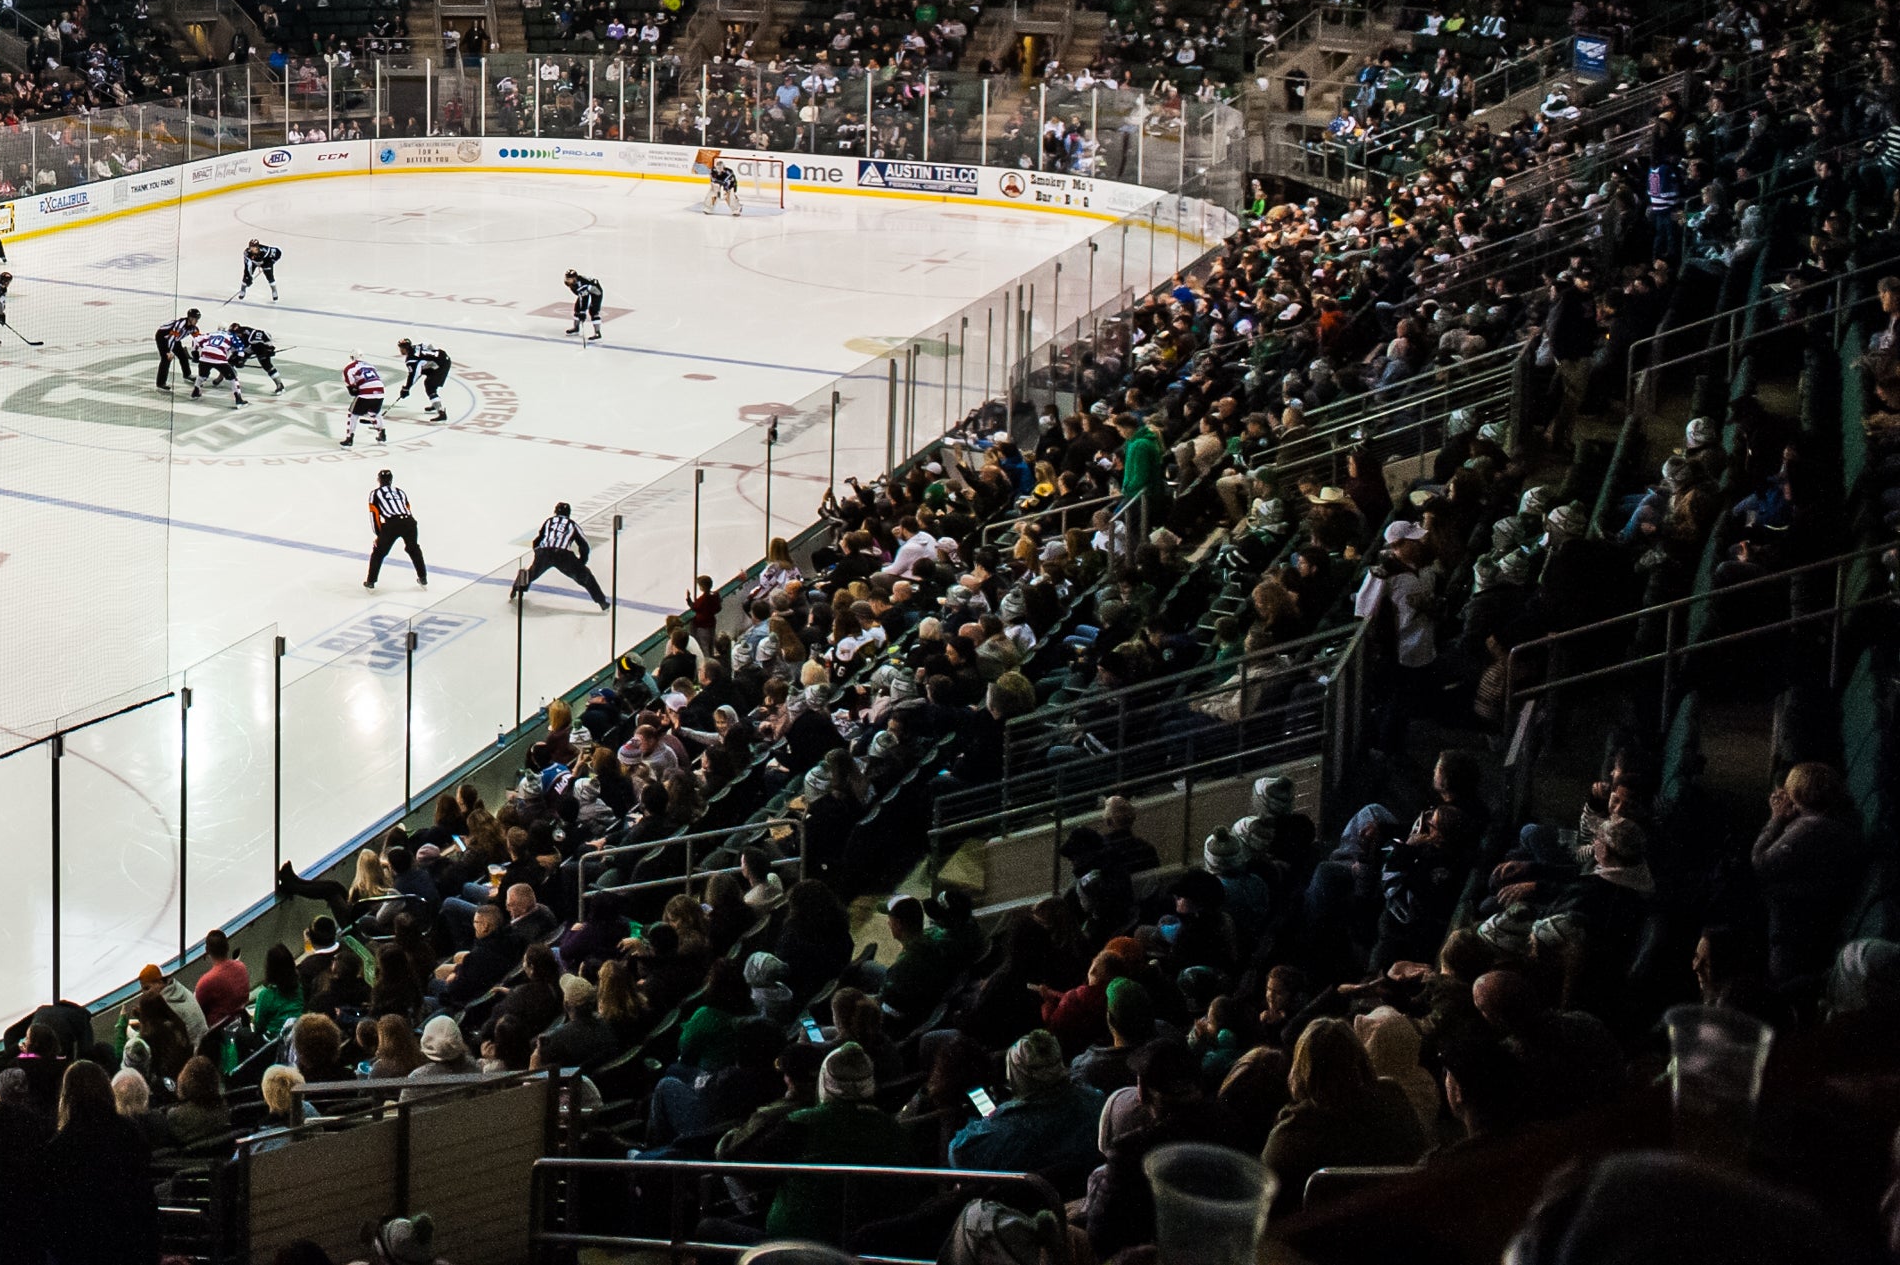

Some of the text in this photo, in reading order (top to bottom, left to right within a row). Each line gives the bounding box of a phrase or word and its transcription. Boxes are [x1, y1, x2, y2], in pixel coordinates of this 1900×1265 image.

[268, 150, 287, 164] AHL
[317, 152, 349, 161] CCM
[562, 149, 604, 158] PRO-LAB
[737, 160, 755, 176] at
[885, 163, 978, 184] AUSTIN TELCO
[131, 184, 149, 193] THANK
[150, 182, 160, 191] YOU
[1030, 173, 1067, 190] Smokey
[40, 192, 88, 213] EXCALIBUR
[1036, 190, 1052, 202] Bar
[350, 283, 520, 309] TOYOTA
[317, 615, 399, 651] BUD
[366, 616, 463, 670] LIGHT
